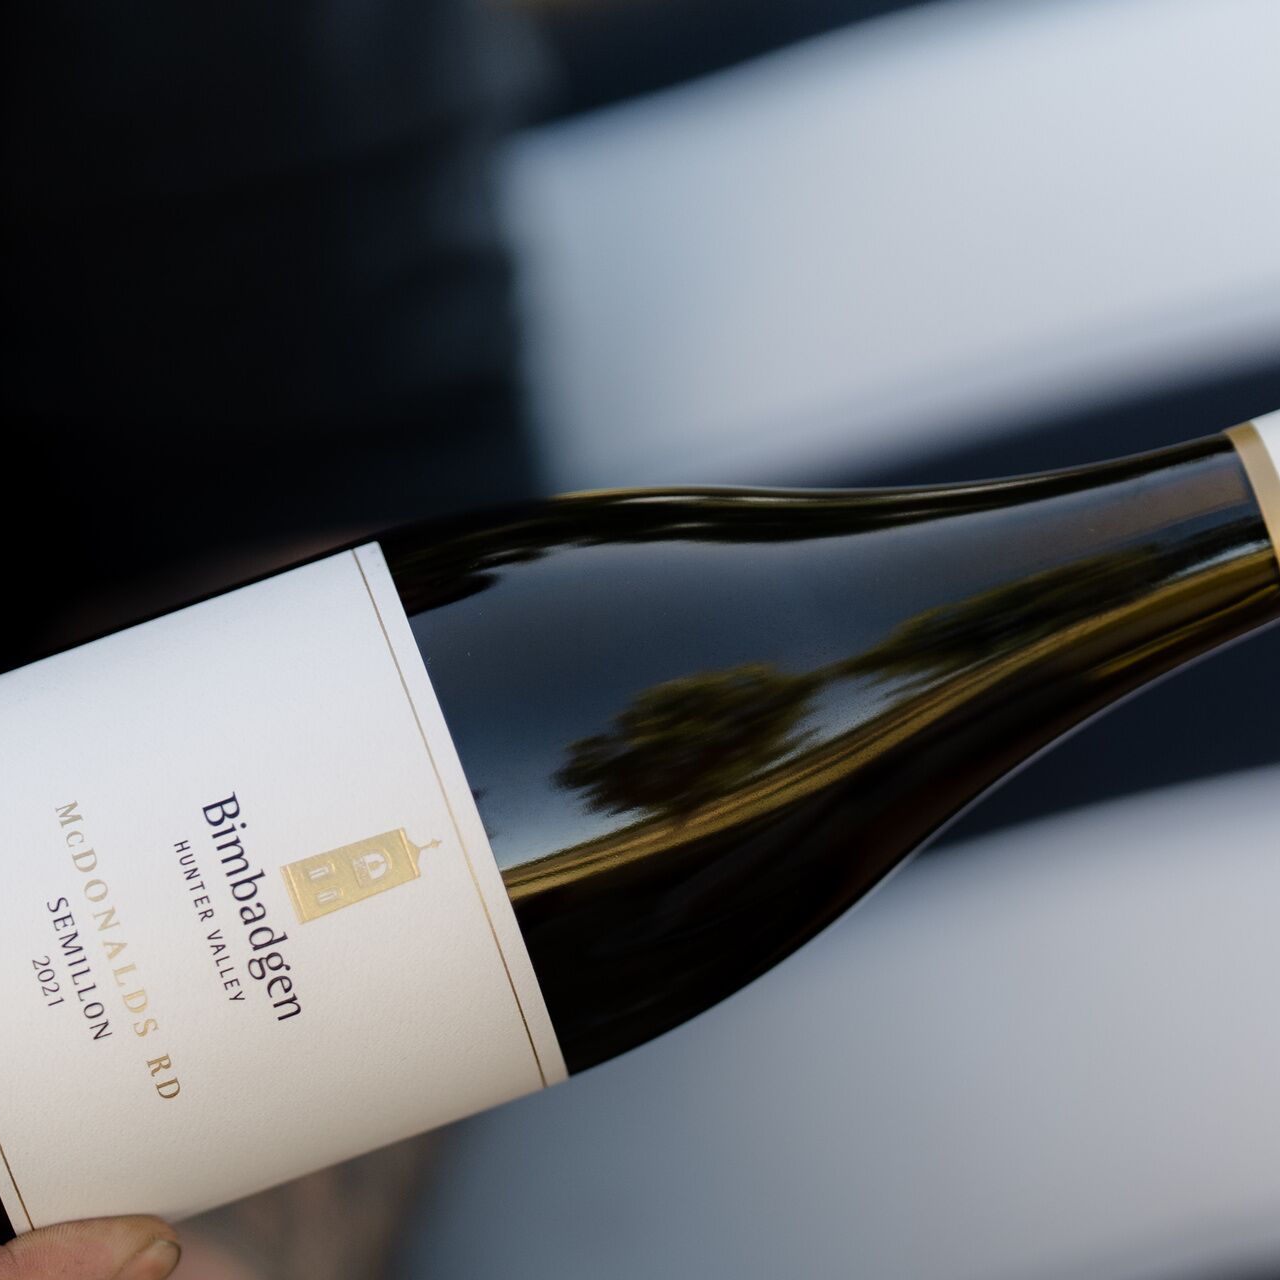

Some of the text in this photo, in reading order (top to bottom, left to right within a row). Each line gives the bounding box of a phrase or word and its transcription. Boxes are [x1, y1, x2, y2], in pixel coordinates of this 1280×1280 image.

[46, 896, 113, 1041] SEMILLON
[173, 839, 245, 1001] HUNTER VALLEY
[202, 791, 302, 1021] Bimbadgen
[32, 955, 65, 1007] 2021
[146, 1053, 181, 1099] RD
